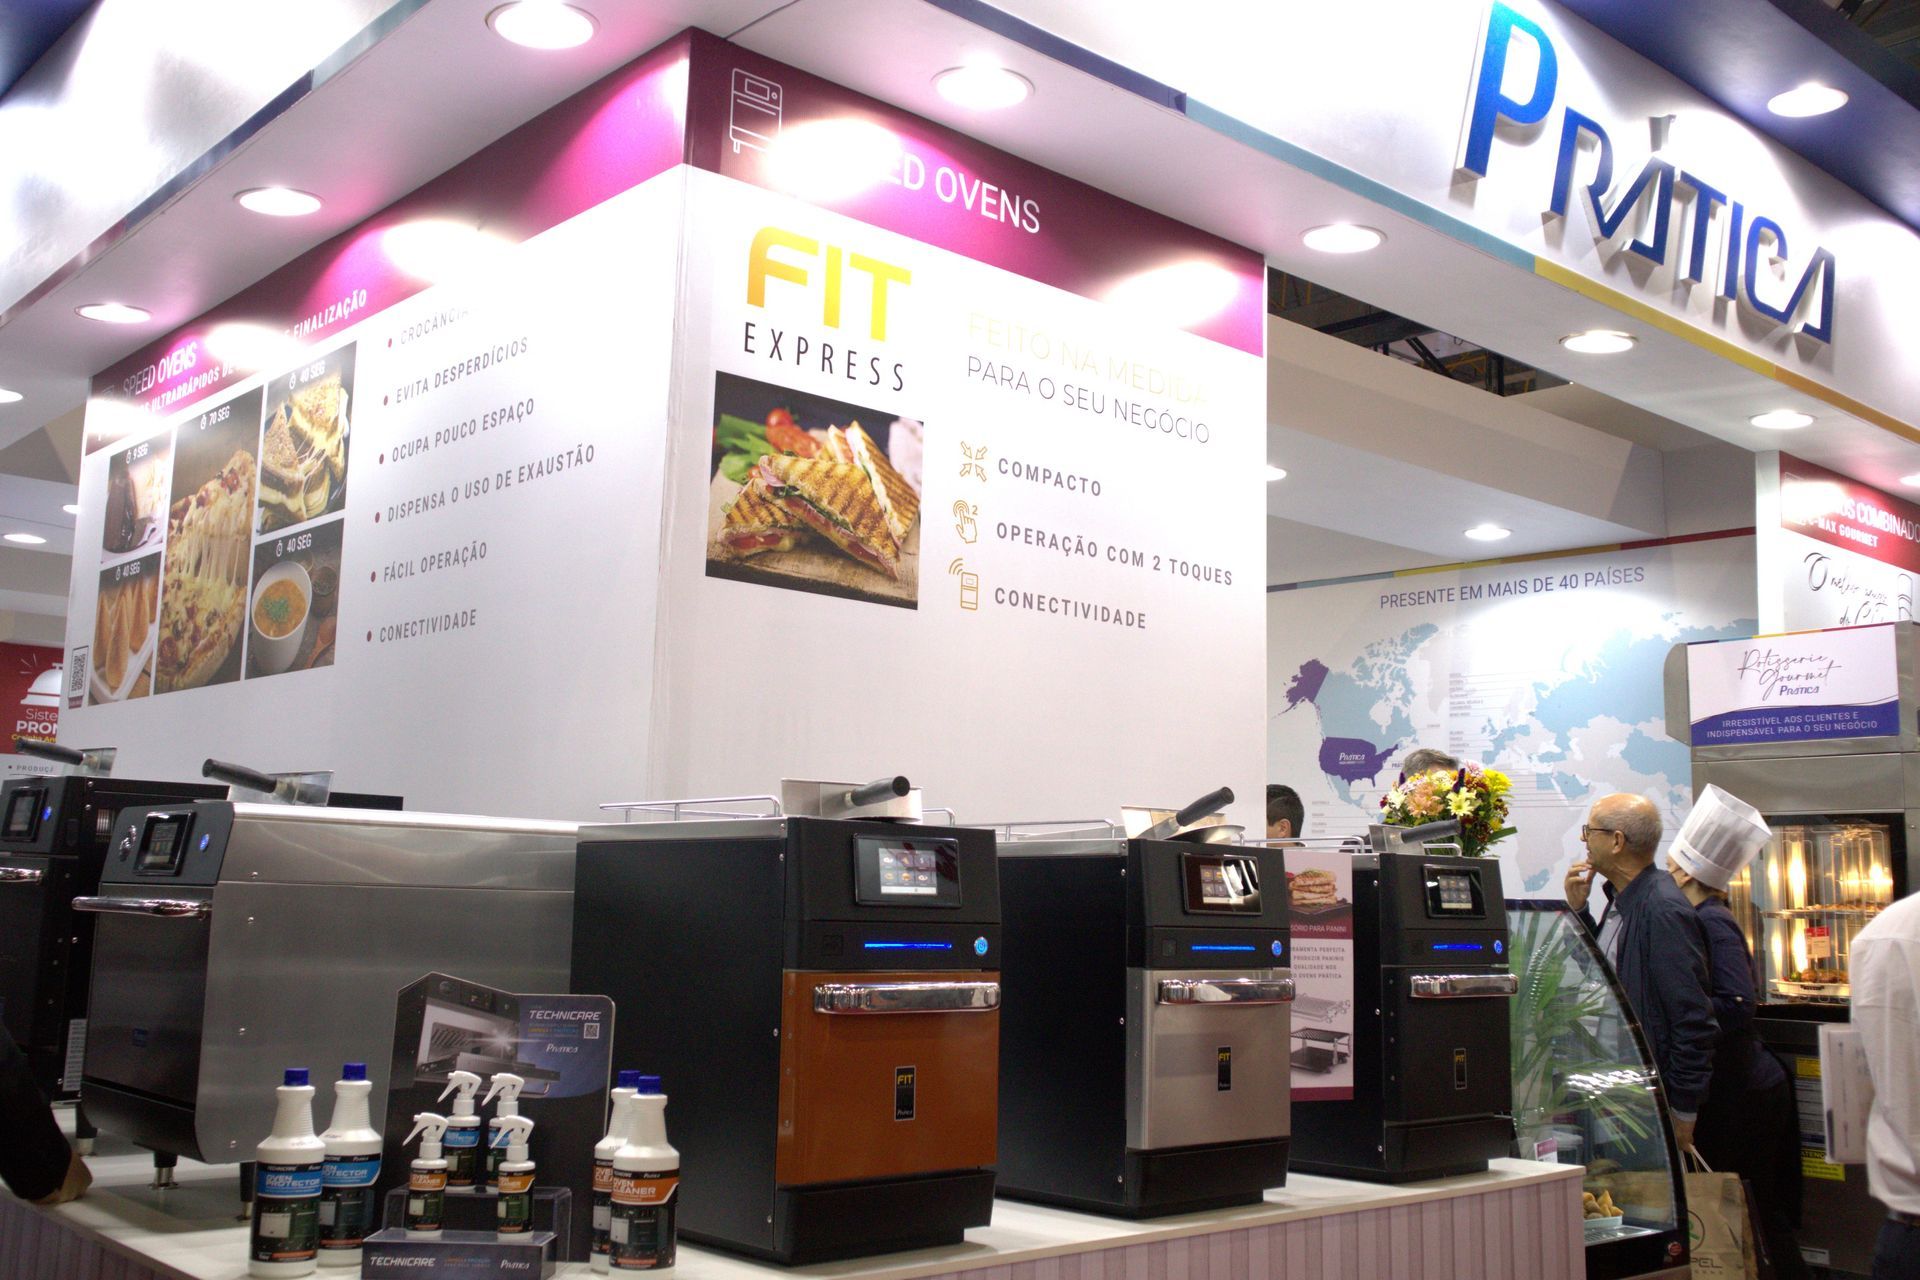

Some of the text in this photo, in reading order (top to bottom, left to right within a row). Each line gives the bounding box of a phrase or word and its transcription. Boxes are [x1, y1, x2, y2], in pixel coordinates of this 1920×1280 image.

[935, 166, 1040, 234] OVENS
[747, 226, 912, 342] FIT
[293, 288, 367, 338] FINALIZAÇÃO
[744, 322, 904, 391] EXPRESS
[968, 312, 1050, 360] FEITO
[1061, 341, 1098, 375] NA
[122, 341, 198, 396] SPEED OVENS
[310, 361, 326, 378] SEG
[396, 336, 528, 403] EVITA DESPERDÍCIOS
[208, 405, 231, 426] 70 SEG
[968, 356, 1209, 444] PARA O SEU NEGÓCIO
[392, 398, 534, 462] OCUPA POUCO ESPAÇO
[137, 443, 148, 458] SEG
[387, 443, 595, 522] DISPENSA O USO DE EXAUSTÃO
[998, 458, 1101, 497] COMPACTO
[286, 533, 312, 553] 40 SEG
[1839, 524, 1879, 548] GOURMET
[122, 561, 141, 577] 40 SEG
[383, 540, 488, 583] FÁCIL OPERAÇÃO
[996, 522, 1232, 586] OPERAÇÃO COM 2 TOQUES
[1380, 565, 1645, 609] PRESENTE EM MAIS DE 40 PAÍSES
[379, 608, 478, 643] CONECTIVIDADE
[995, 587, 1146, 629] CONECTIVIDADE
[25, 708, 58, 722] Siste
[1707, 720, 1878, 739] INDISPENSÁVEL PARA O SEU NEGÓCIO
[1722, 711, 1859, 728] IRRESISTÍVEL AOS CLIENTES E
[529, 1010, 602, 1021] TECHNICARE
[1218, 1052, 1231, 1062] FIT
[897, 1074, 914, 1086] FIT
[595, 1168, 613, 1176] OVE
[613, 1186, 657, 1195] CLEANER
[370, 1256, 436, 1267] TECHNICARE
